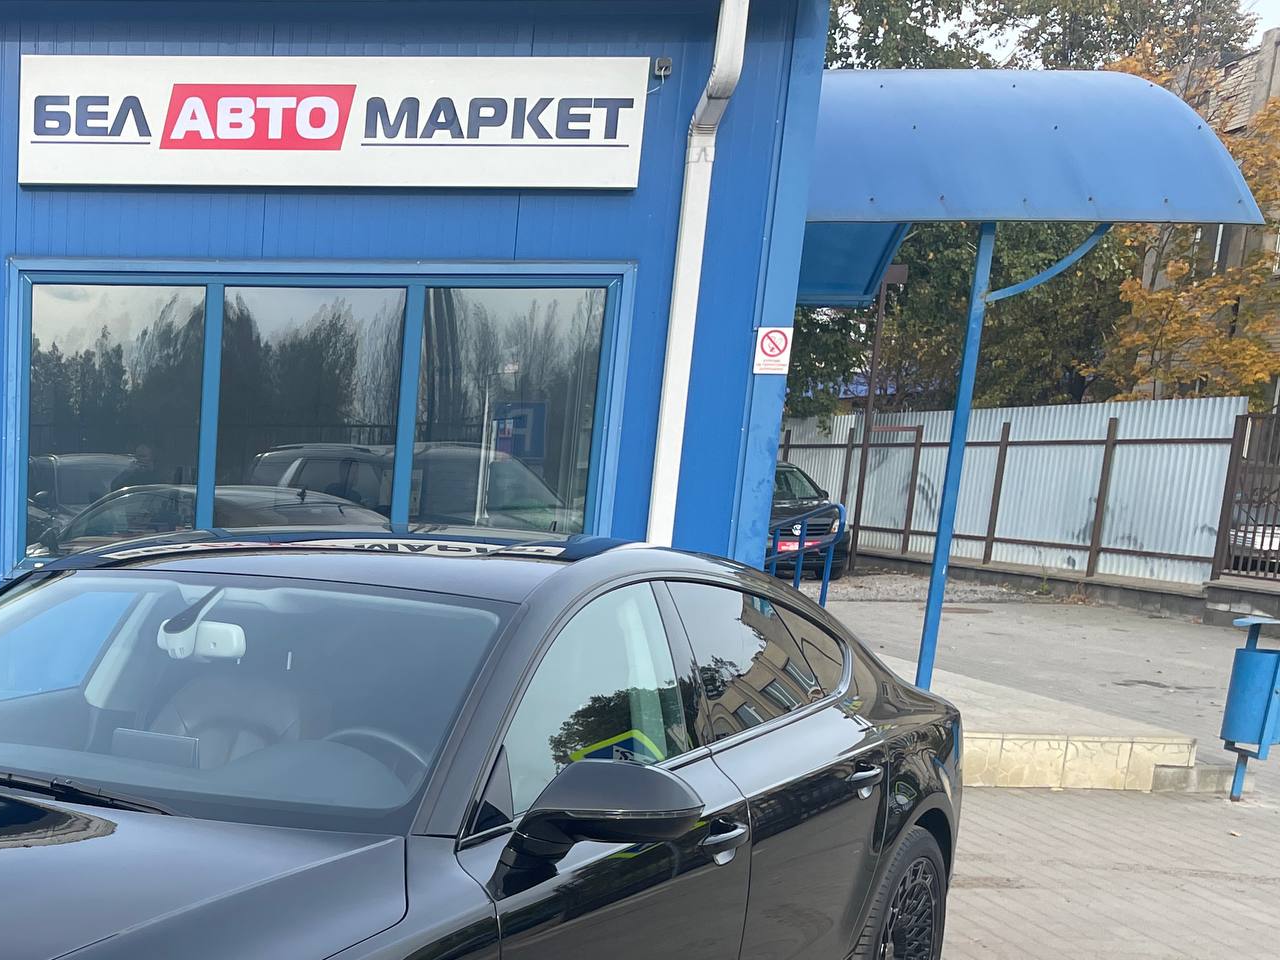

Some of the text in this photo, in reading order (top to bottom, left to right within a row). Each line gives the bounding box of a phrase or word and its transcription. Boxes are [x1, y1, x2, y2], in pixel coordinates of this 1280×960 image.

[33, 95, 634, 140] БЕЛ АВТО МАРКЕТ
